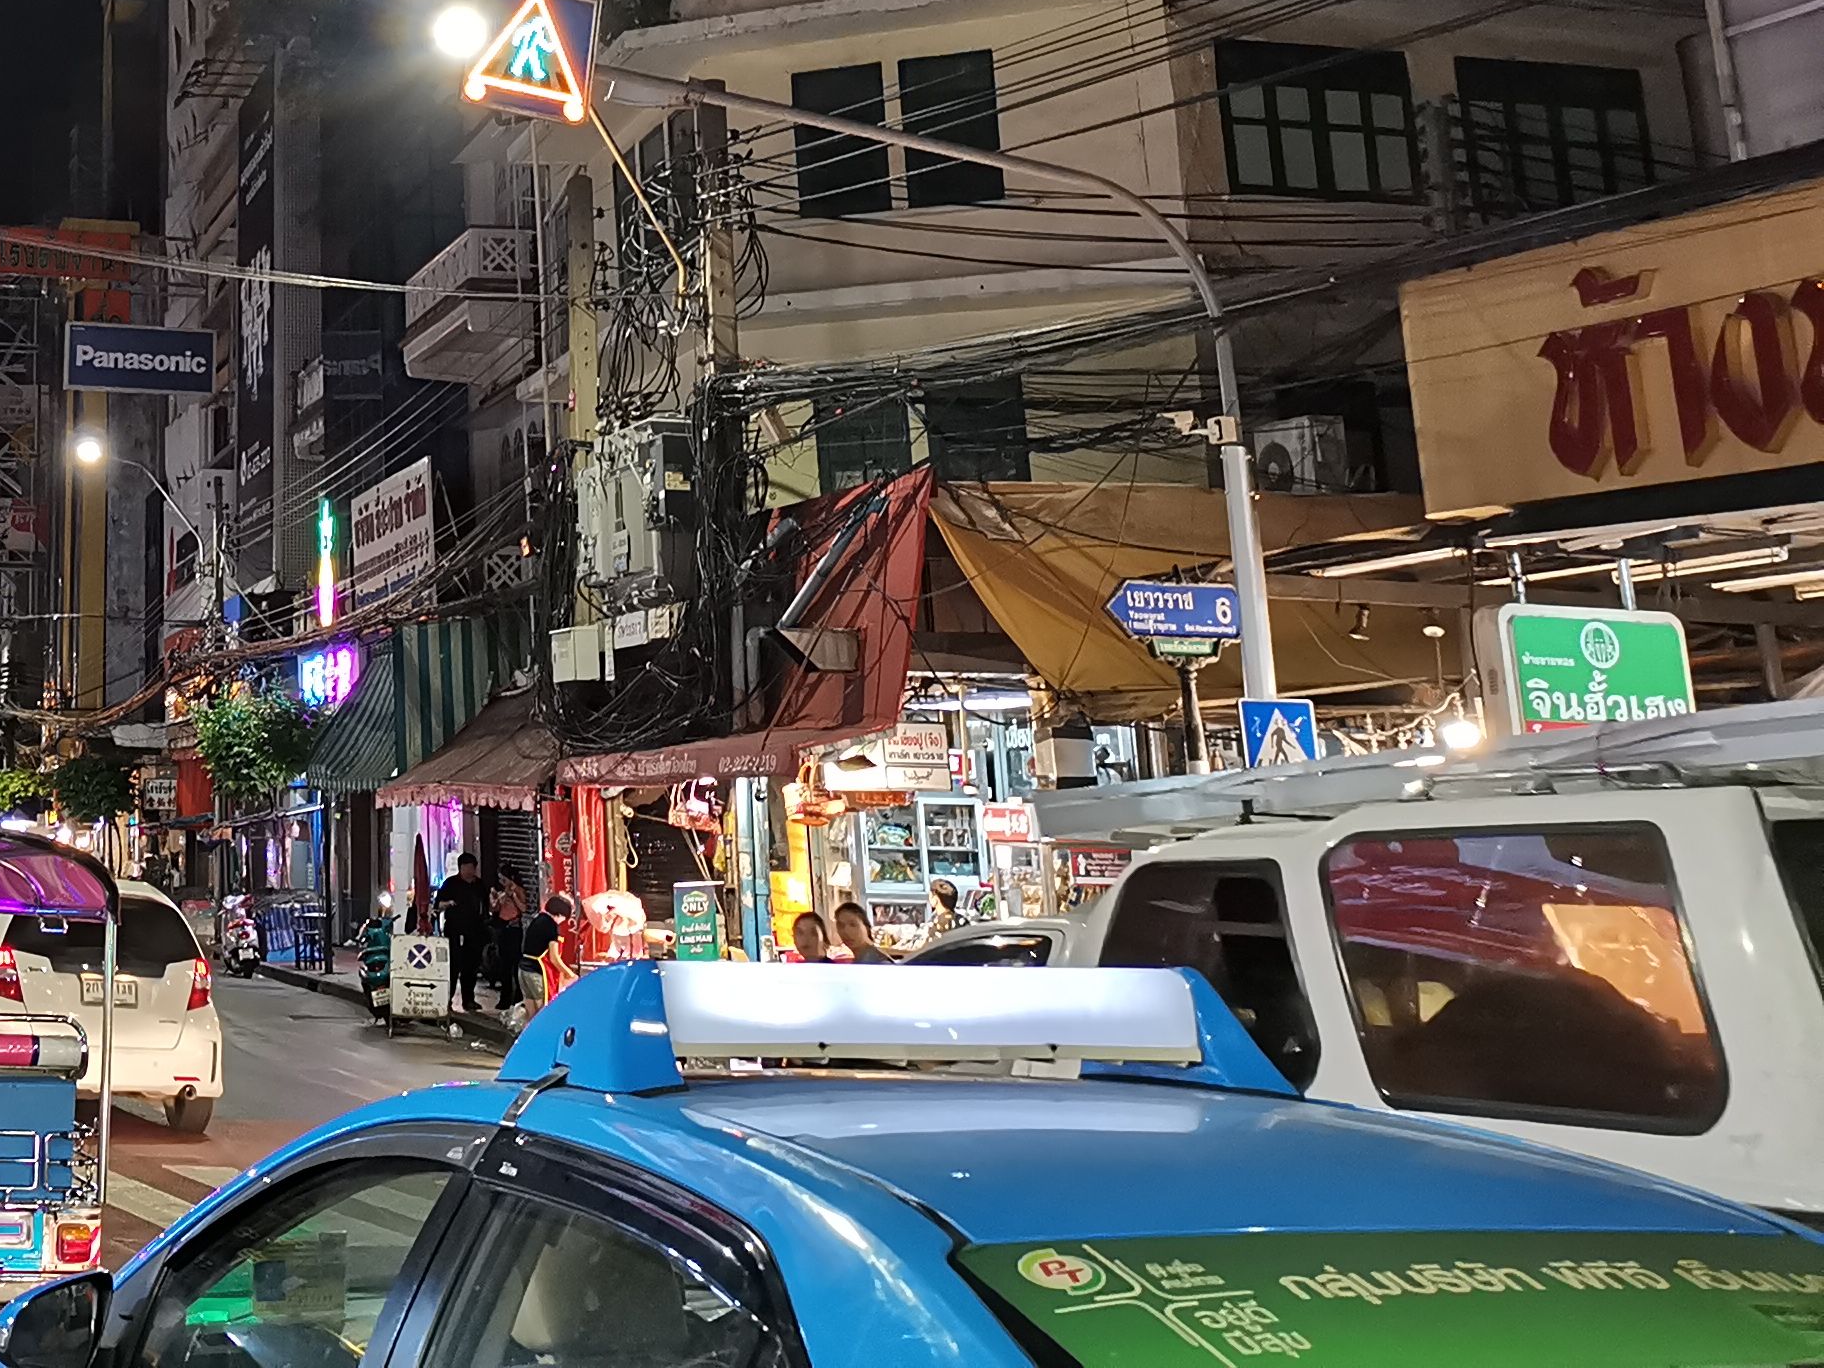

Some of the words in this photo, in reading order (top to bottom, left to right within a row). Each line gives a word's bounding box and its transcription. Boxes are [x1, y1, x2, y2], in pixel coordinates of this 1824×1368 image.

[76, 344, 207, 374] Panasonic
[1126, 590, 1194, 610] เยาวราช
[1215, 597, 1232, 624] 6
[681, 900, 710, 914] ONLY
[1279, 1260, 1546, 1305] กลุ่มบริษัท
